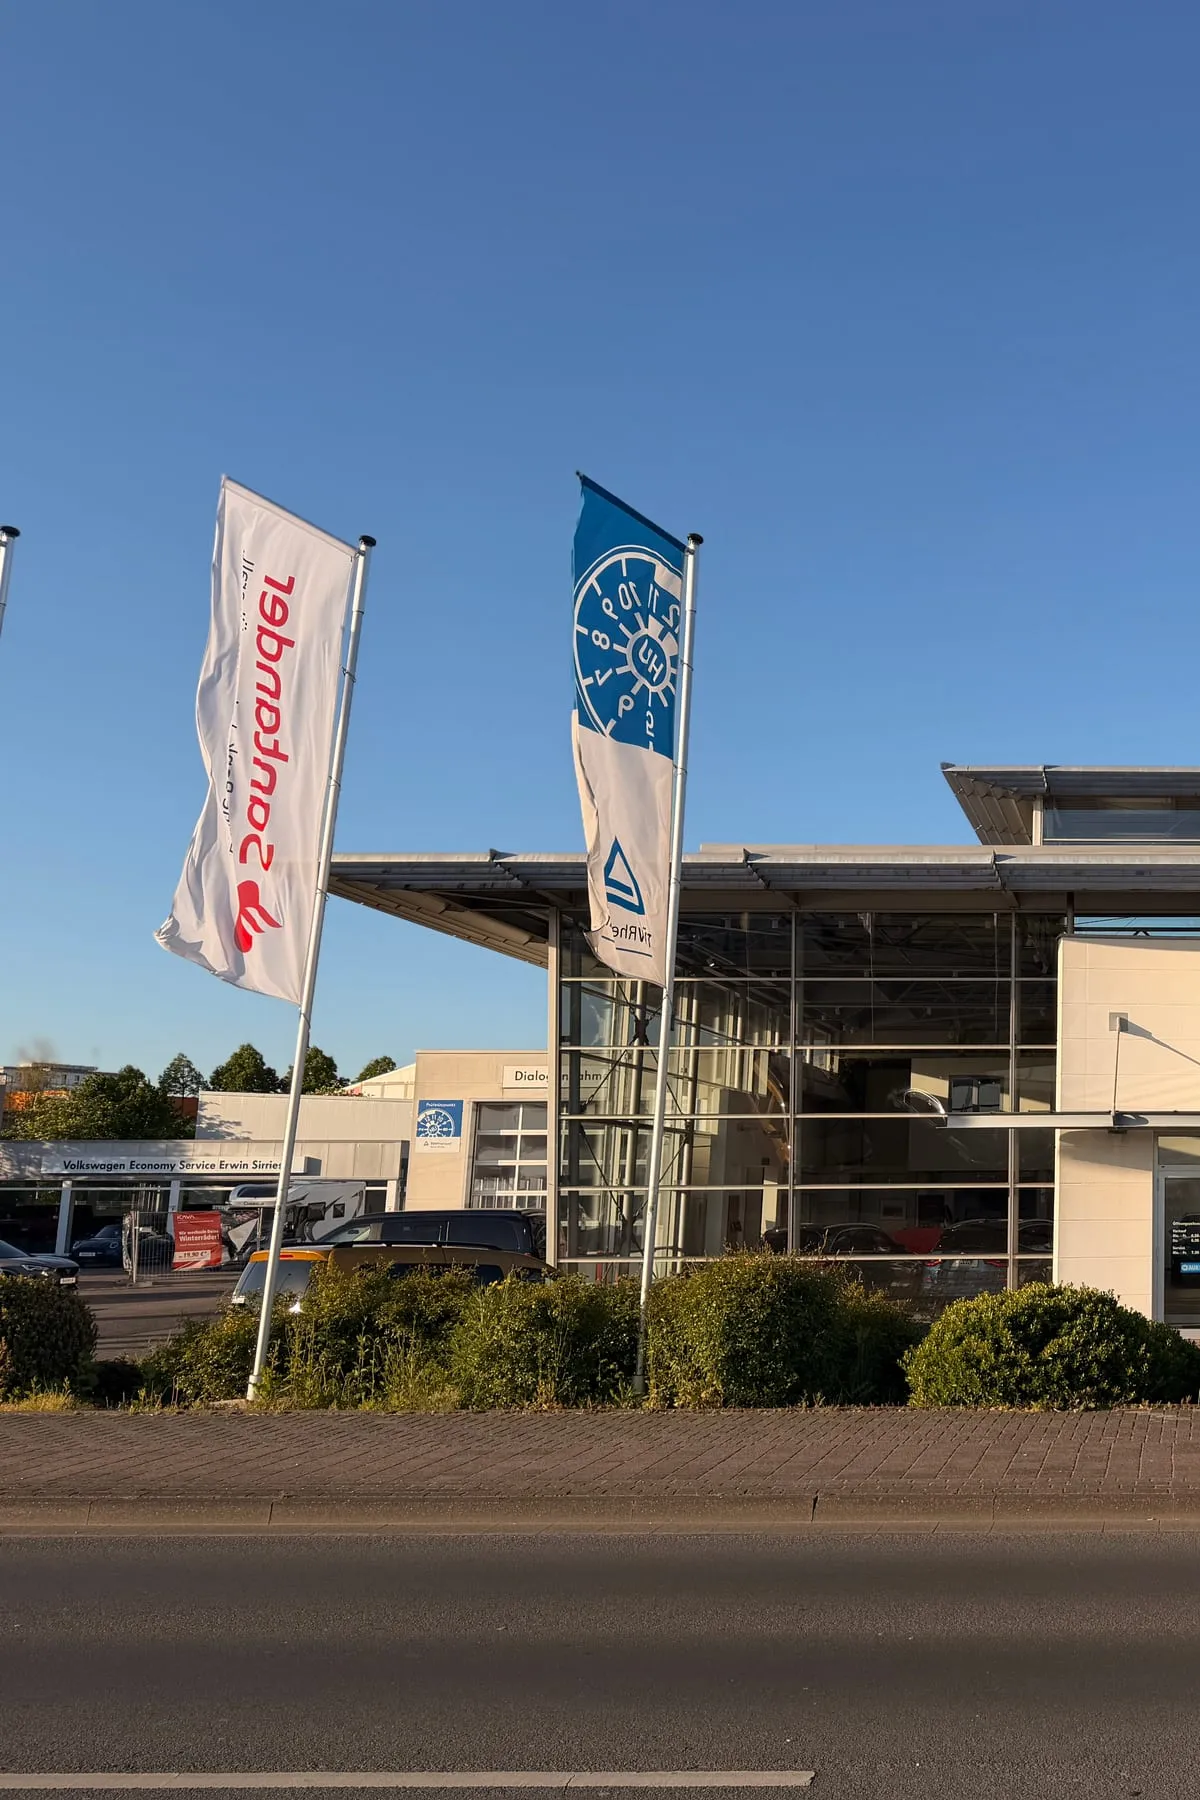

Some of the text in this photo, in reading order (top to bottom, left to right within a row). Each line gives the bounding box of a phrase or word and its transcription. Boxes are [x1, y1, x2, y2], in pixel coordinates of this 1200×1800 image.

[63, 1160, 126, 1172] Volkswagen
[129, 1160, 176, 1172] Economy
[179, 1160, 216, 1170] Service
[219, 1160, 249, 1170] Erwin
